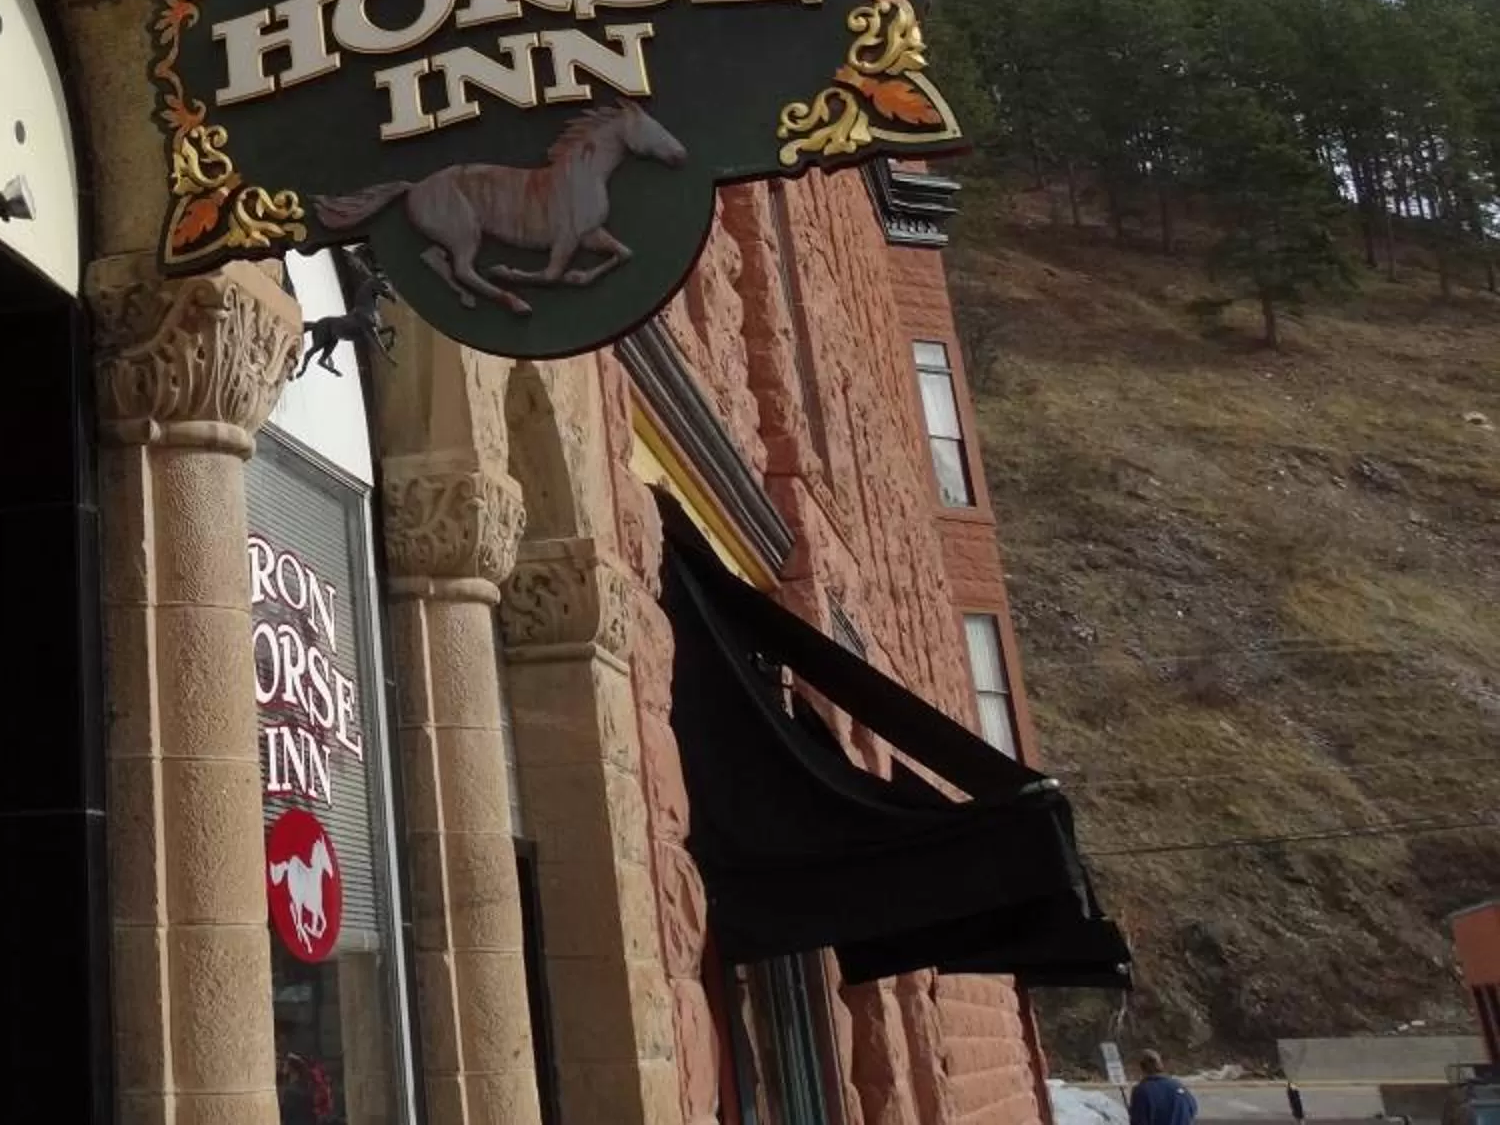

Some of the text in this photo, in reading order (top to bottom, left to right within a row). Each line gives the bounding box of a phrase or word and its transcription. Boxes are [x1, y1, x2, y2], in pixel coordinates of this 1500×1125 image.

[377, 23, 654, 140] INN
[248, 535, 336, 653] RON
[251, 619, 363, 760] ORSE
[264, 725, 332, 805] INN
